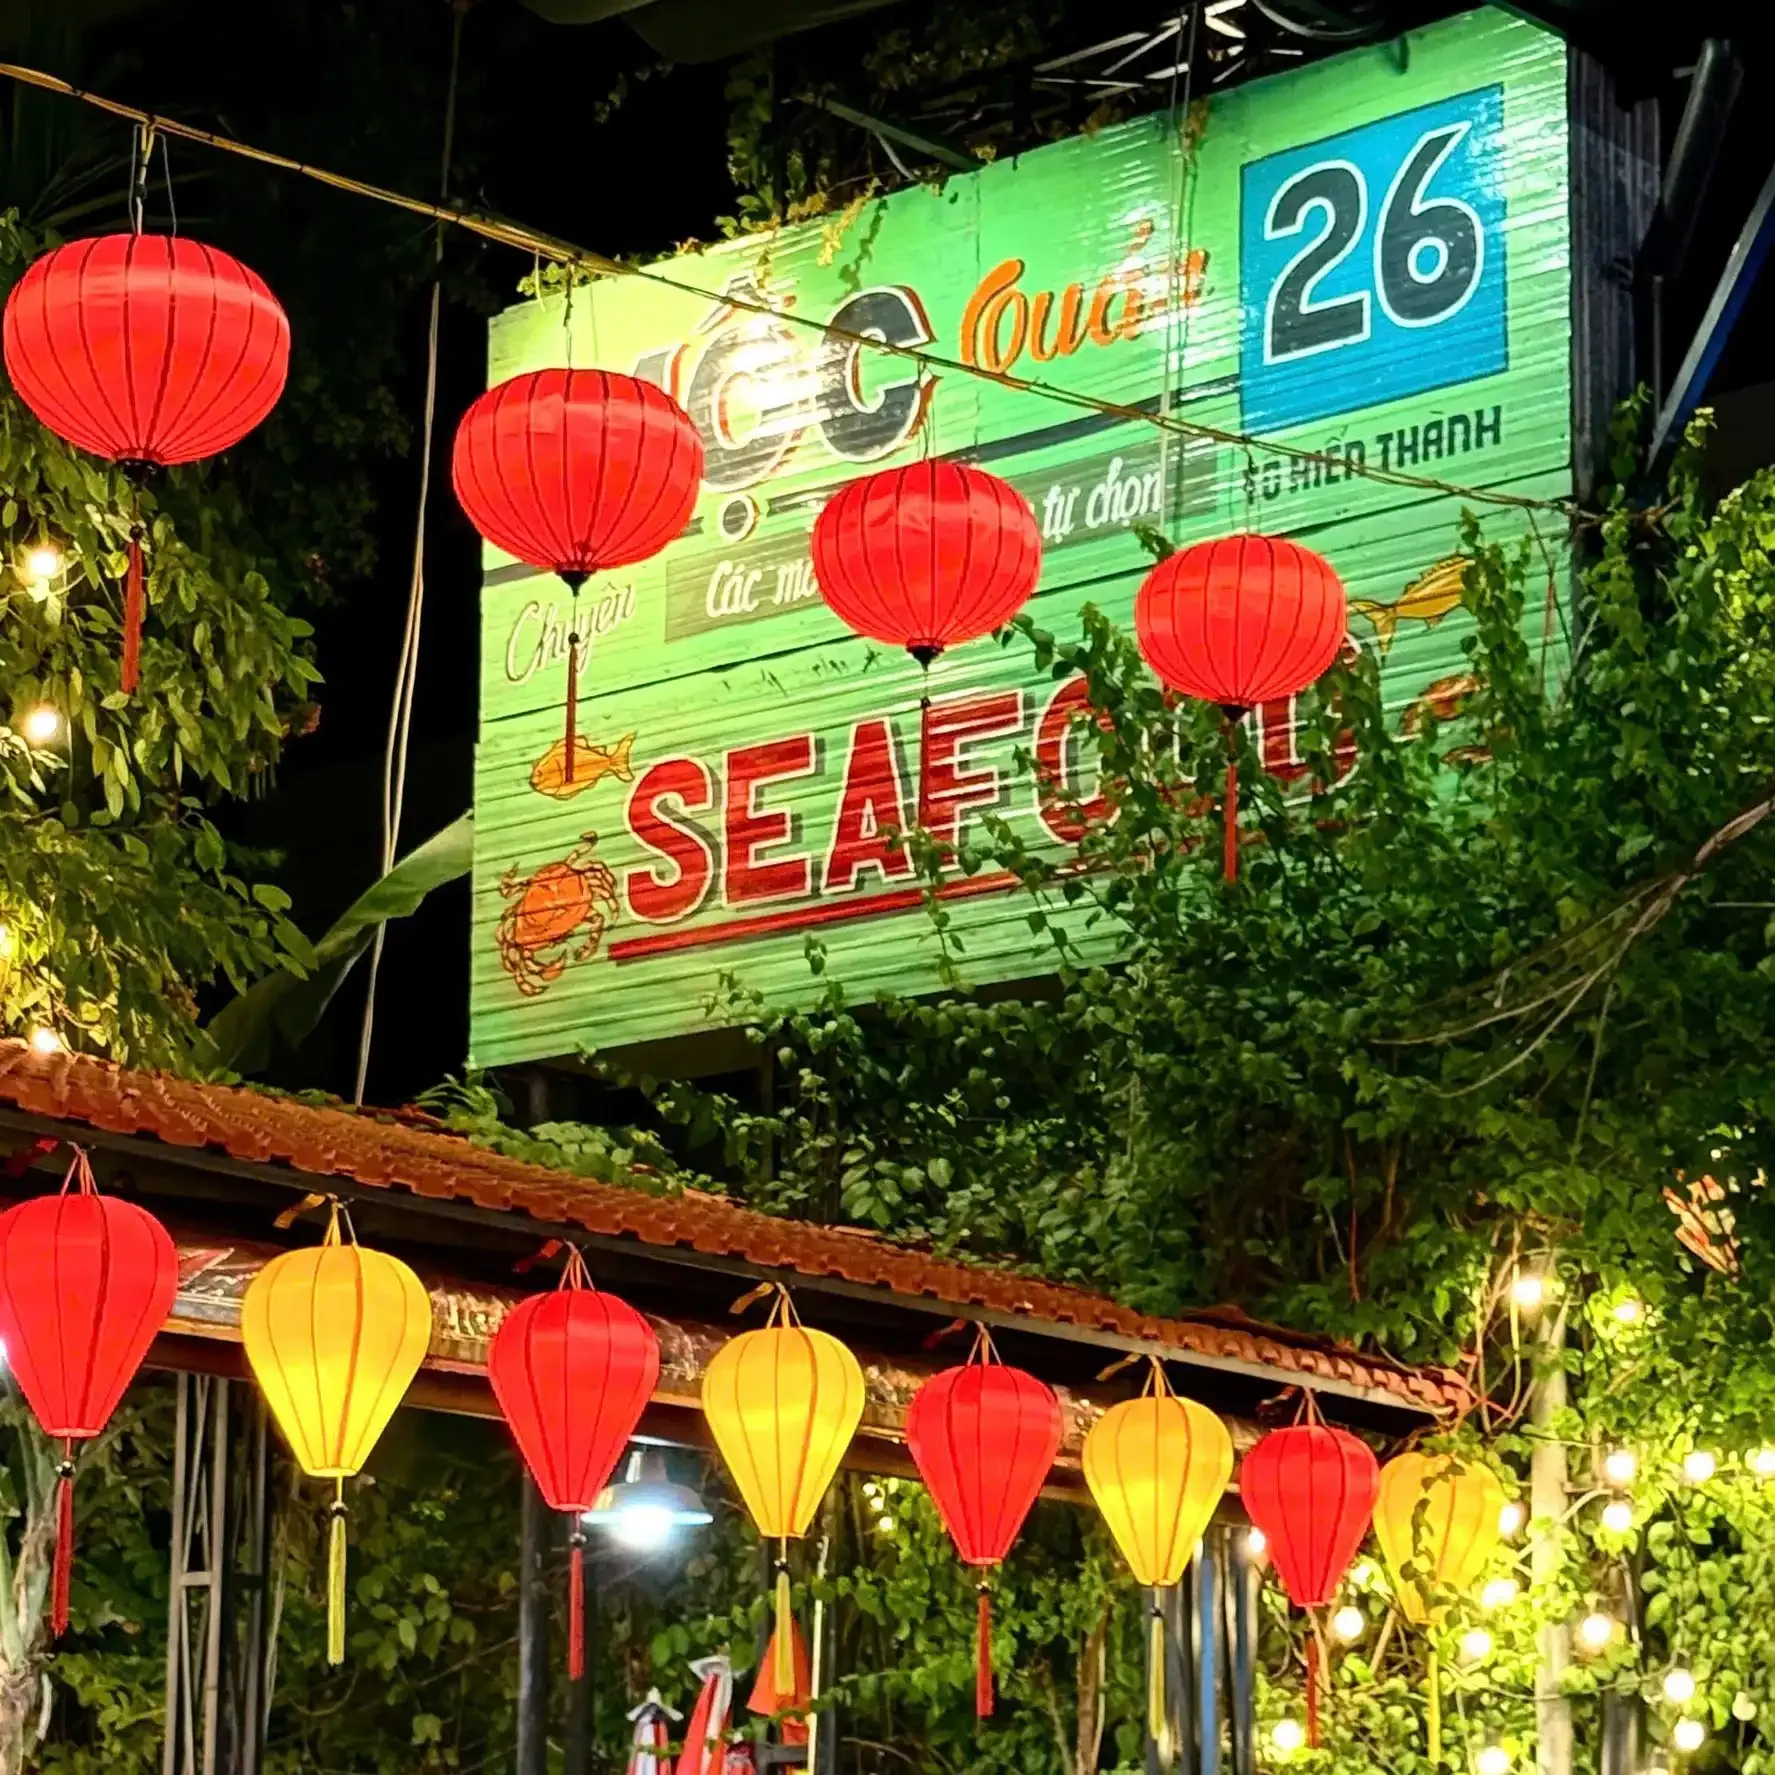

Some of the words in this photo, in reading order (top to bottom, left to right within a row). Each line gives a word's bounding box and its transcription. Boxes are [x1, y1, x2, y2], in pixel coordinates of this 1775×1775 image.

[1264, 121, 1485, 366] 26
[632, 272, 934, 541] ỘC
[1376, 405, 1502, 473] THÀNH
[505, 581, 637, 685] Chuyên
[706, 559, 763, 618] Các
[1042, 484, 1081, 543] tự
[1085, 456, 1162, 529] chọn
[622, 632, 1362, 925] SEAFO
